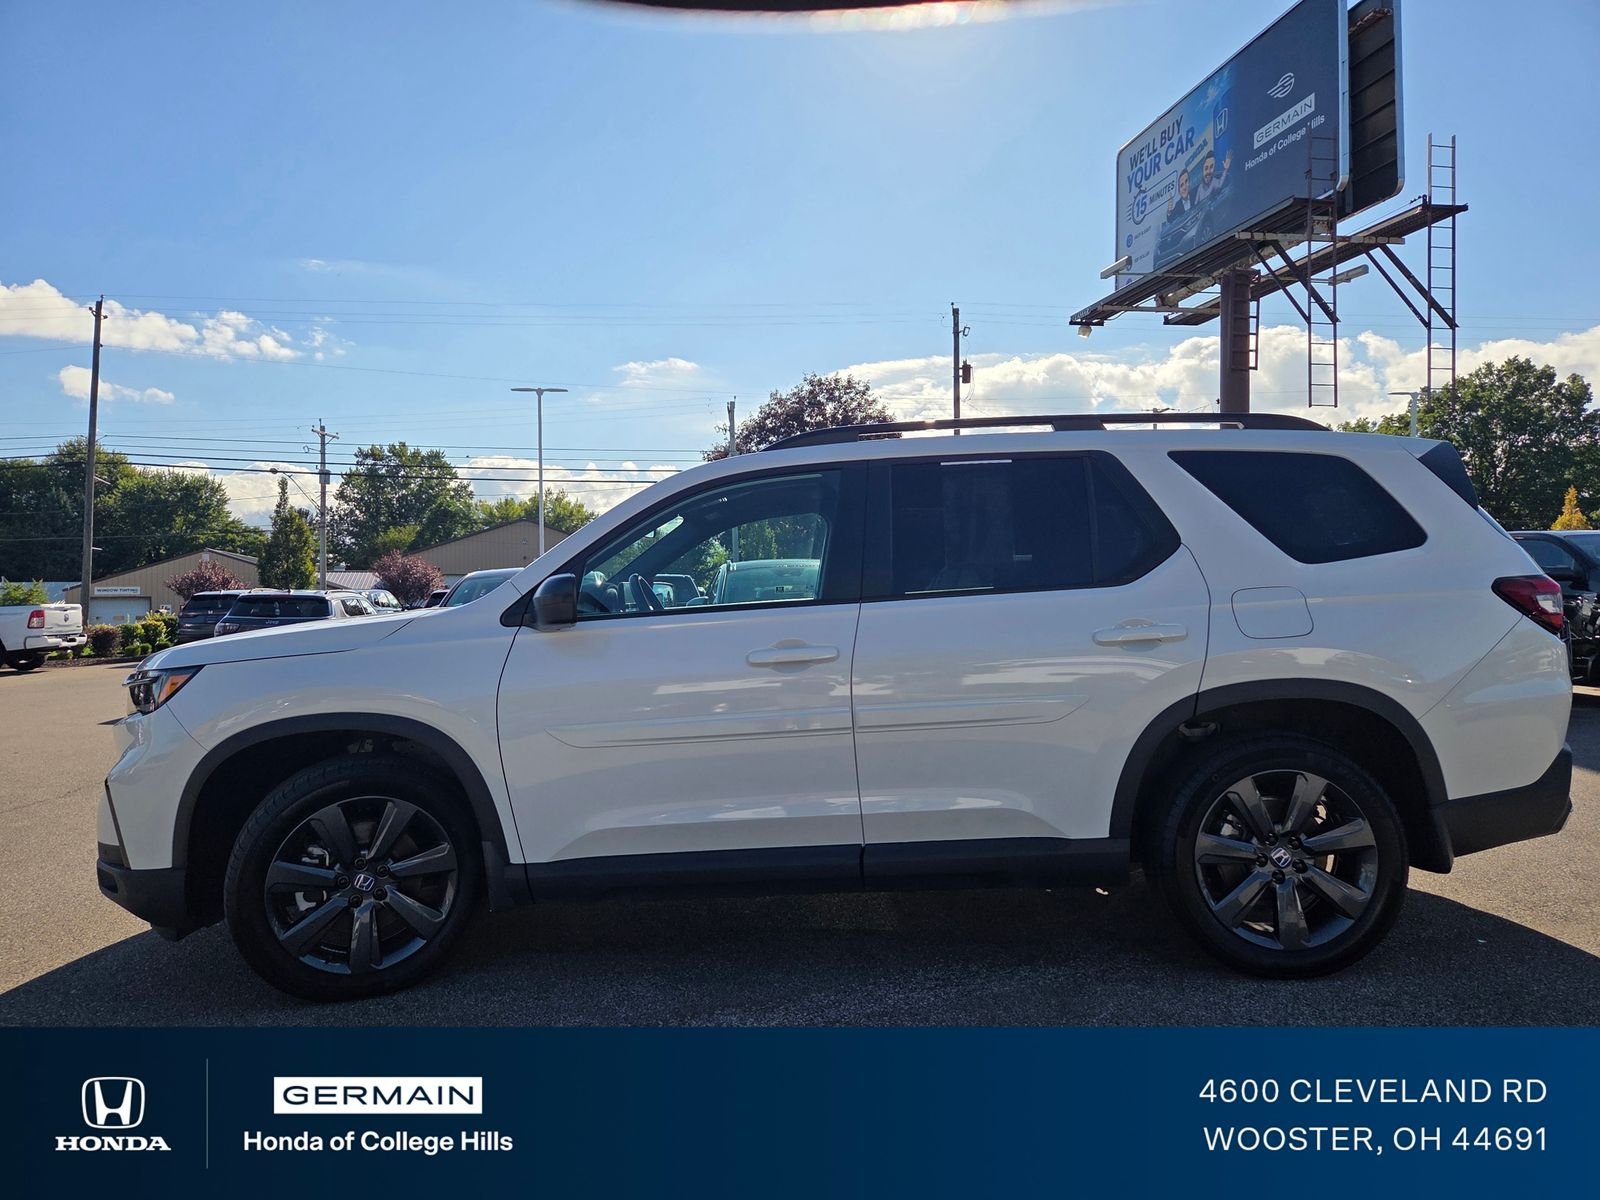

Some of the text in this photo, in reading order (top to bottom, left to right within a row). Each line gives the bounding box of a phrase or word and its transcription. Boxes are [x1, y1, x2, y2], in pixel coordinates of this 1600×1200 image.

[1130, 138, 1158, 171] WE'LL
[1160, 114, 1184, 148] BUY
[1256, 99, 1313, 143] GERMAIN
[1127, 152, 1162, 194] YOUR
[1165, 126, 1195, 166] CAR
[1245, 152, 1268, 172] Honda
[1269, 143, 1277, 156] of
[1278, 127, 1307, 150] College
[1136, 180, 1175, 218] 15 MINUTES
